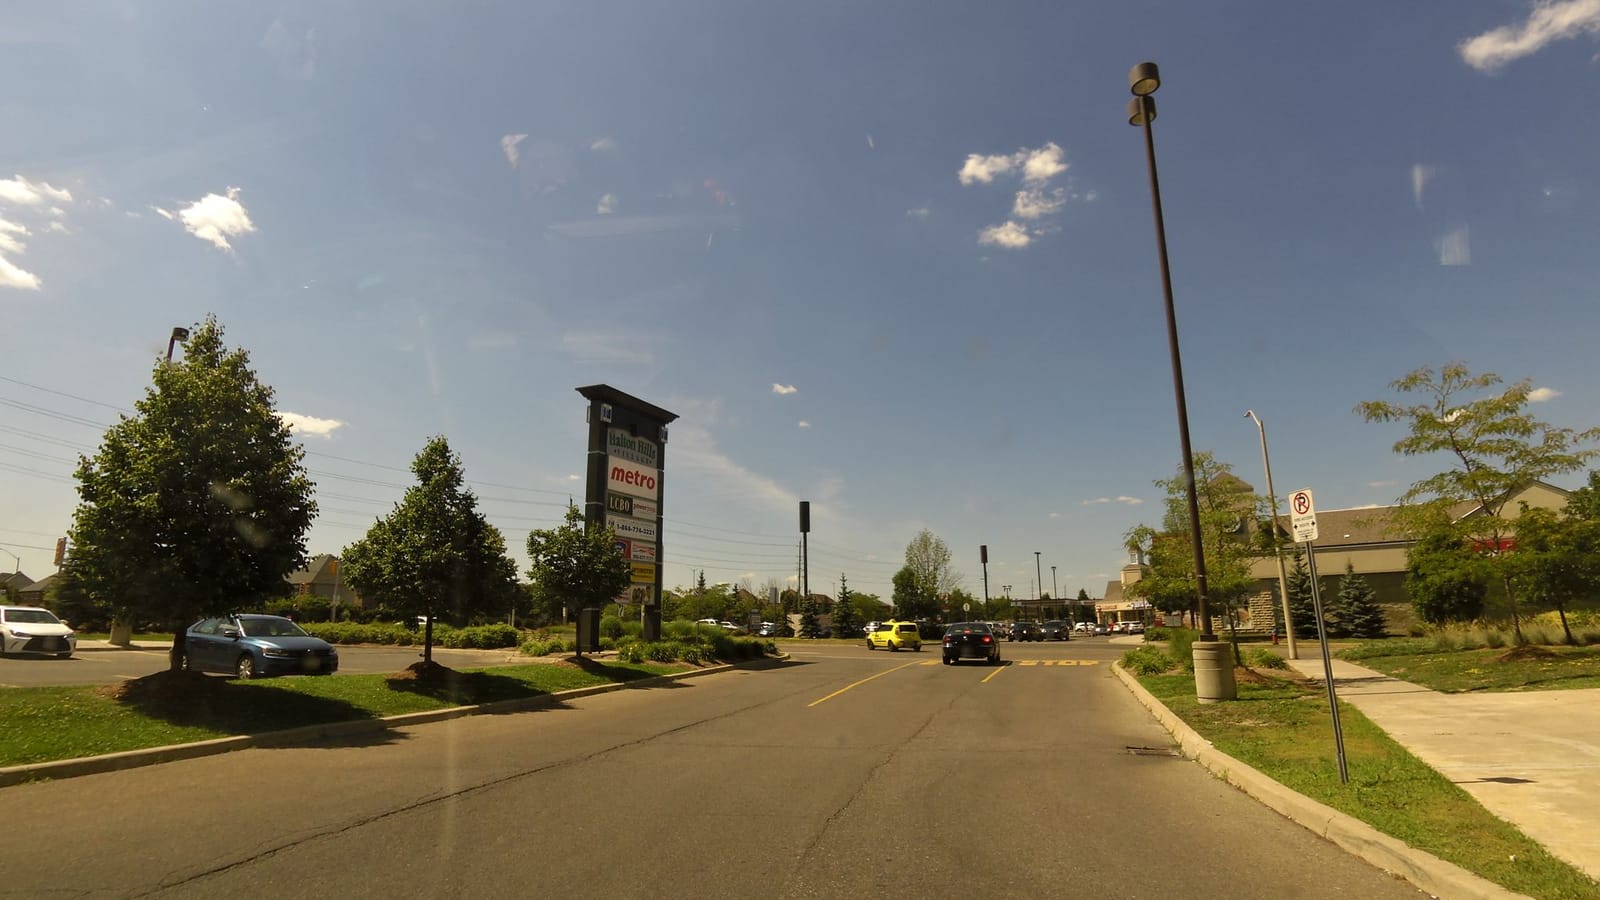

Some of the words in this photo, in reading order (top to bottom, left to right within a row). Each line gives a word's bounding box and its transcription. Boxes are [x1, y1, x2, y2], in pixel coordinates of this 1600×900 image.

[609, 432, 636, 450] Halton
[638, 440, 656, 459] Hills
[611, 466, 655, 490] metro
[610, 496, 630, 512] LCBO
